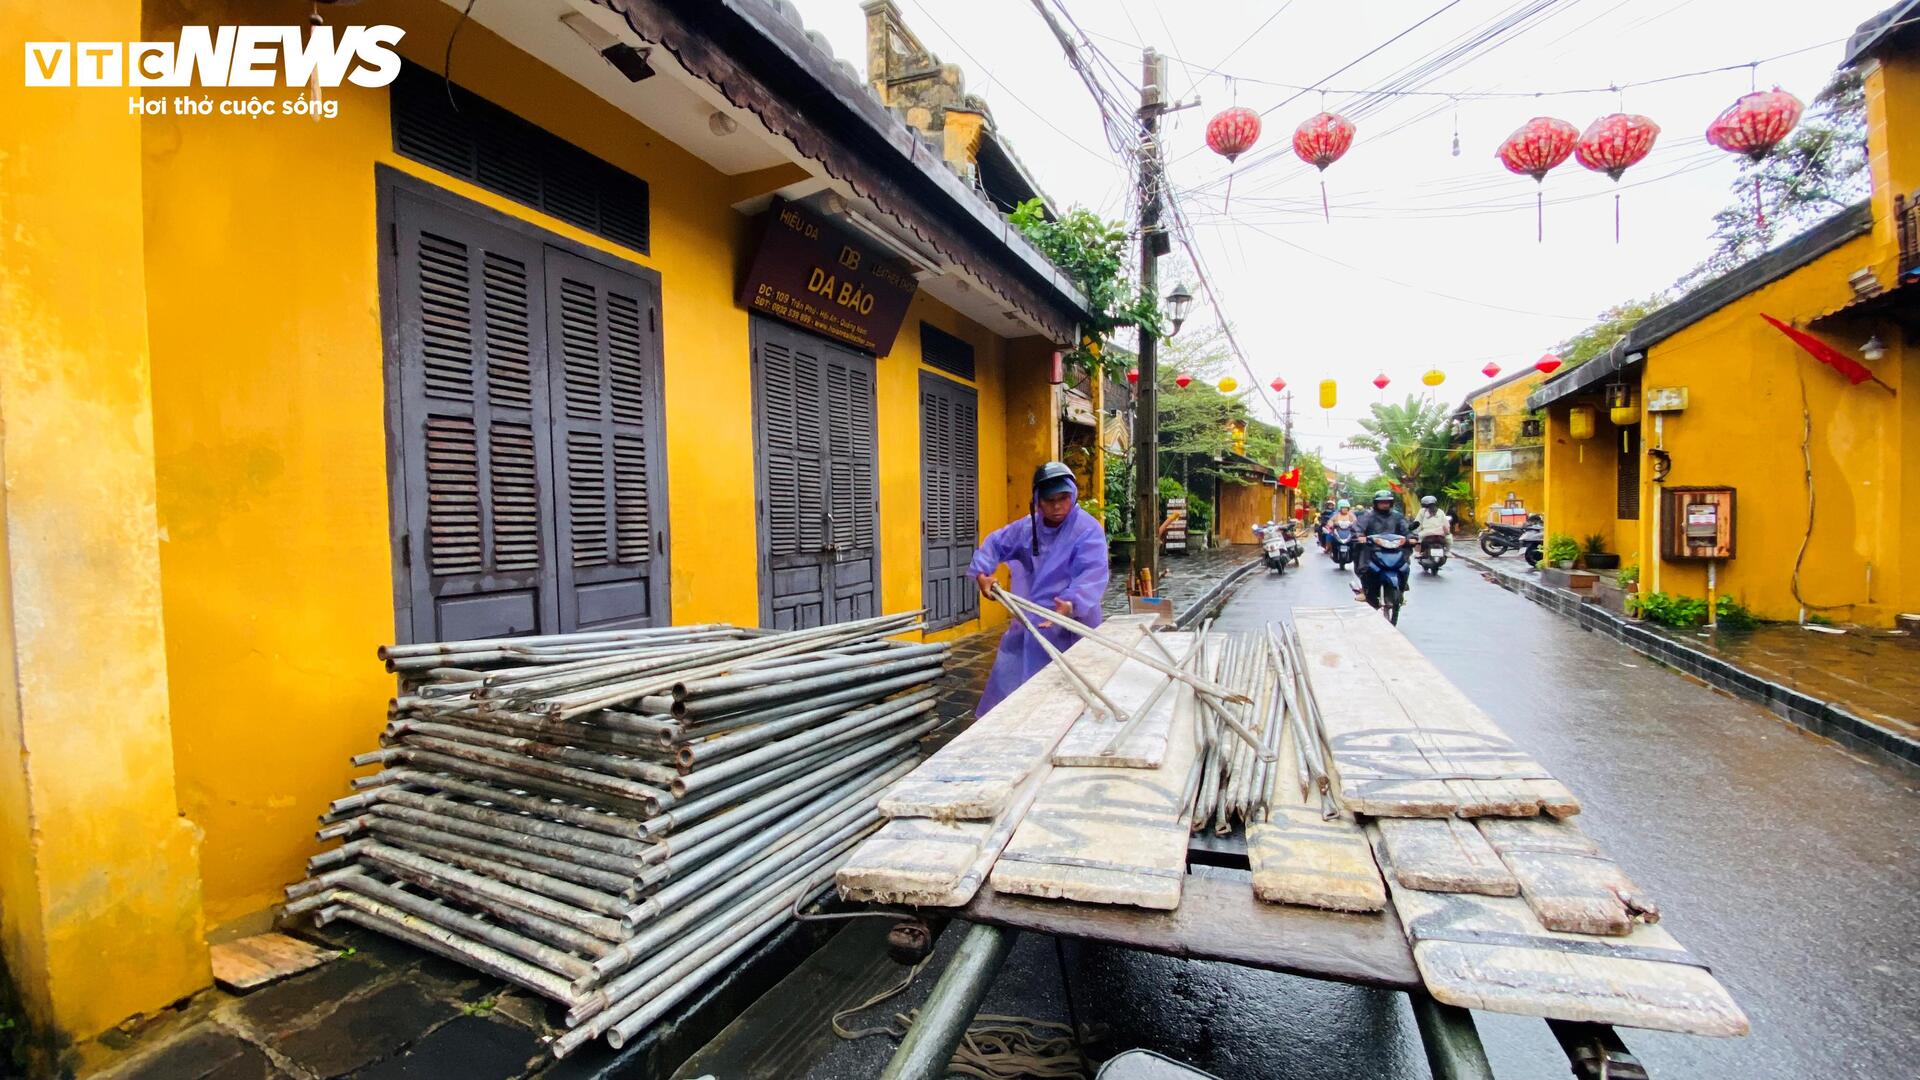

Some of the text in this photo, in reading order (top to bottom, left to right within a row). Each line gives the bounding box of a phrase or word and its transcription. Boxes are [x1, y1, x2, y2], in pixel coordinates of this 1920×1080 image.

[804, 223, 820, 241] DA
[776, 290, 790, 304] 109
[808, 267, 875, 316] DA BẢO
